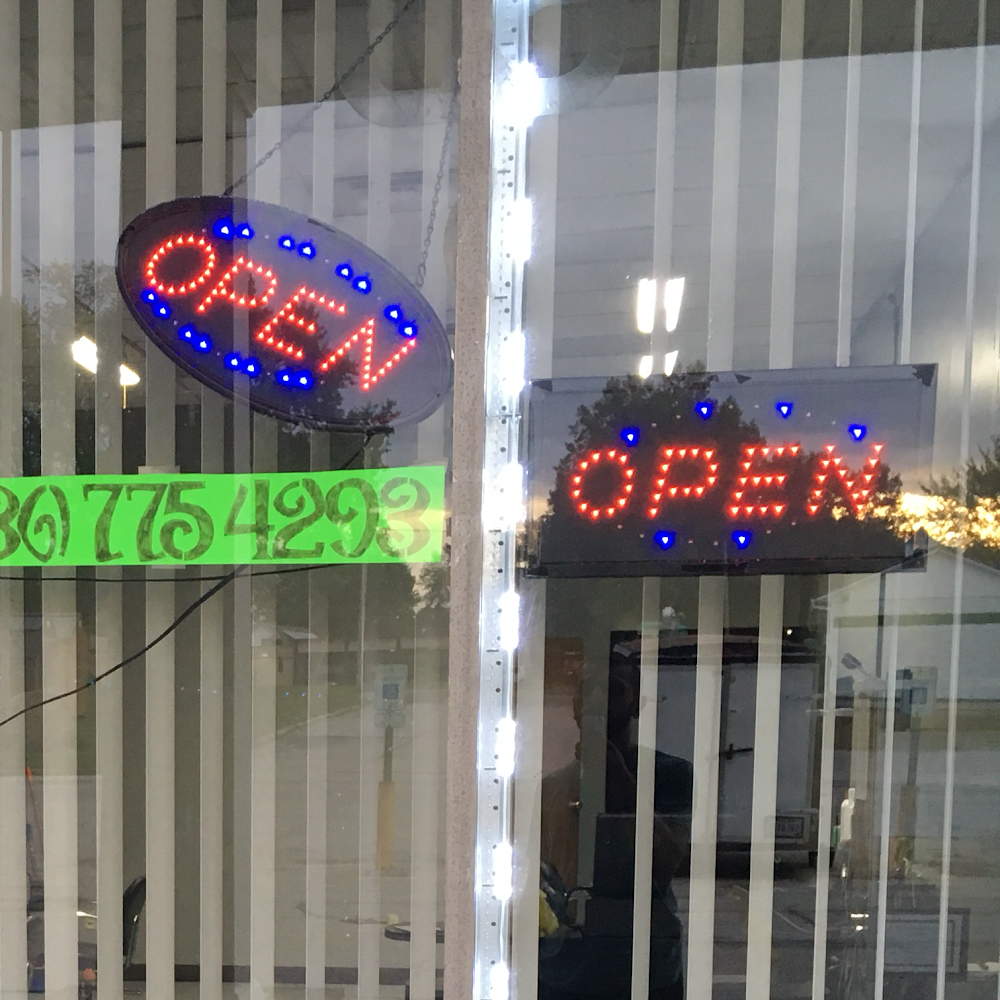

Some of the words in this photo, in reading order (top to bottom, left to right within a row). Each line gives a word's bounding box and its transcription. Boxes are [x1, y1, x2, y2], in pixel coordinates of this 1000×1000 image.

[144, 233, 418, 392] OPEN
[84, 480, 215, 562] 775
[224, 476, 432, 561] 4293
[571, 443, 886, 519] OPEN
